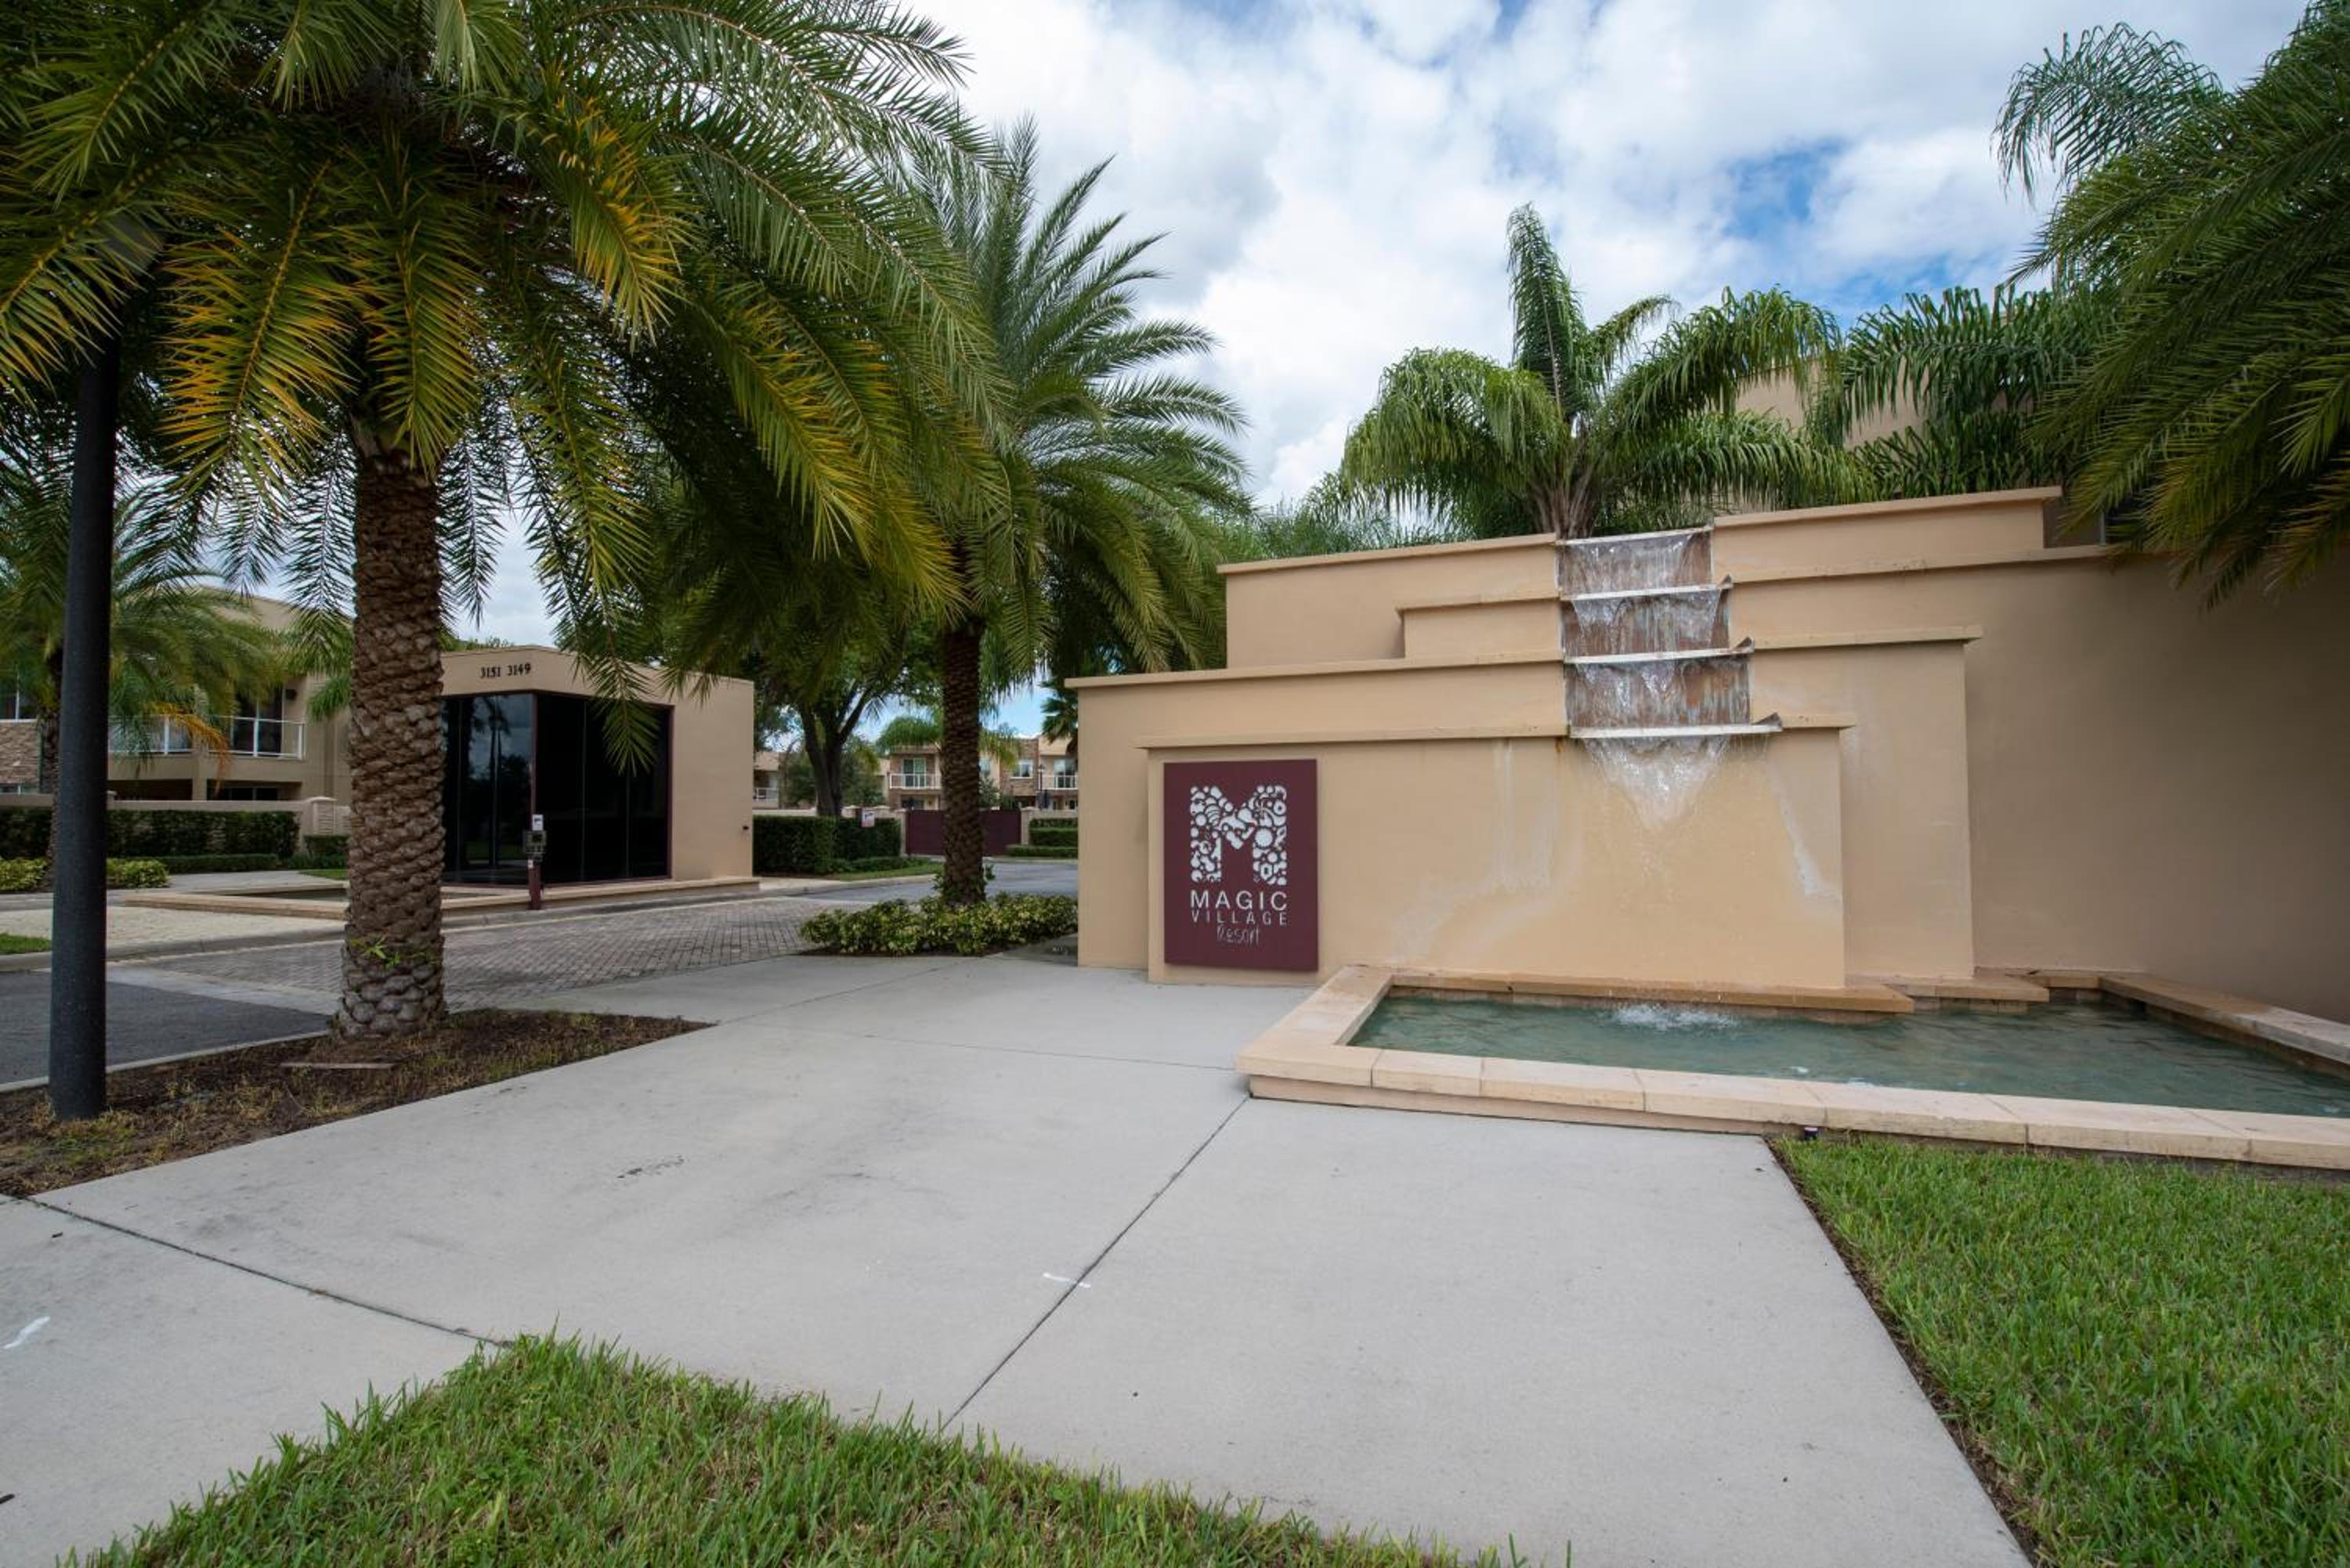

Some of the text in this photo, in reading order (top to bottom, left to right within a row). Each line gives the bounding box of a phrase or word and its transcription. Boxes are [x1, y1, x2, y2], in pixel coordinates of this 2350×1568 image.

[480, 663, 531, 679] 3151 3149
[1191, 890, 1287, 911] MAGIC
[1191, 909, 1287, 926] VILLAGE
[1217, 924, 1260, 945] Resort
